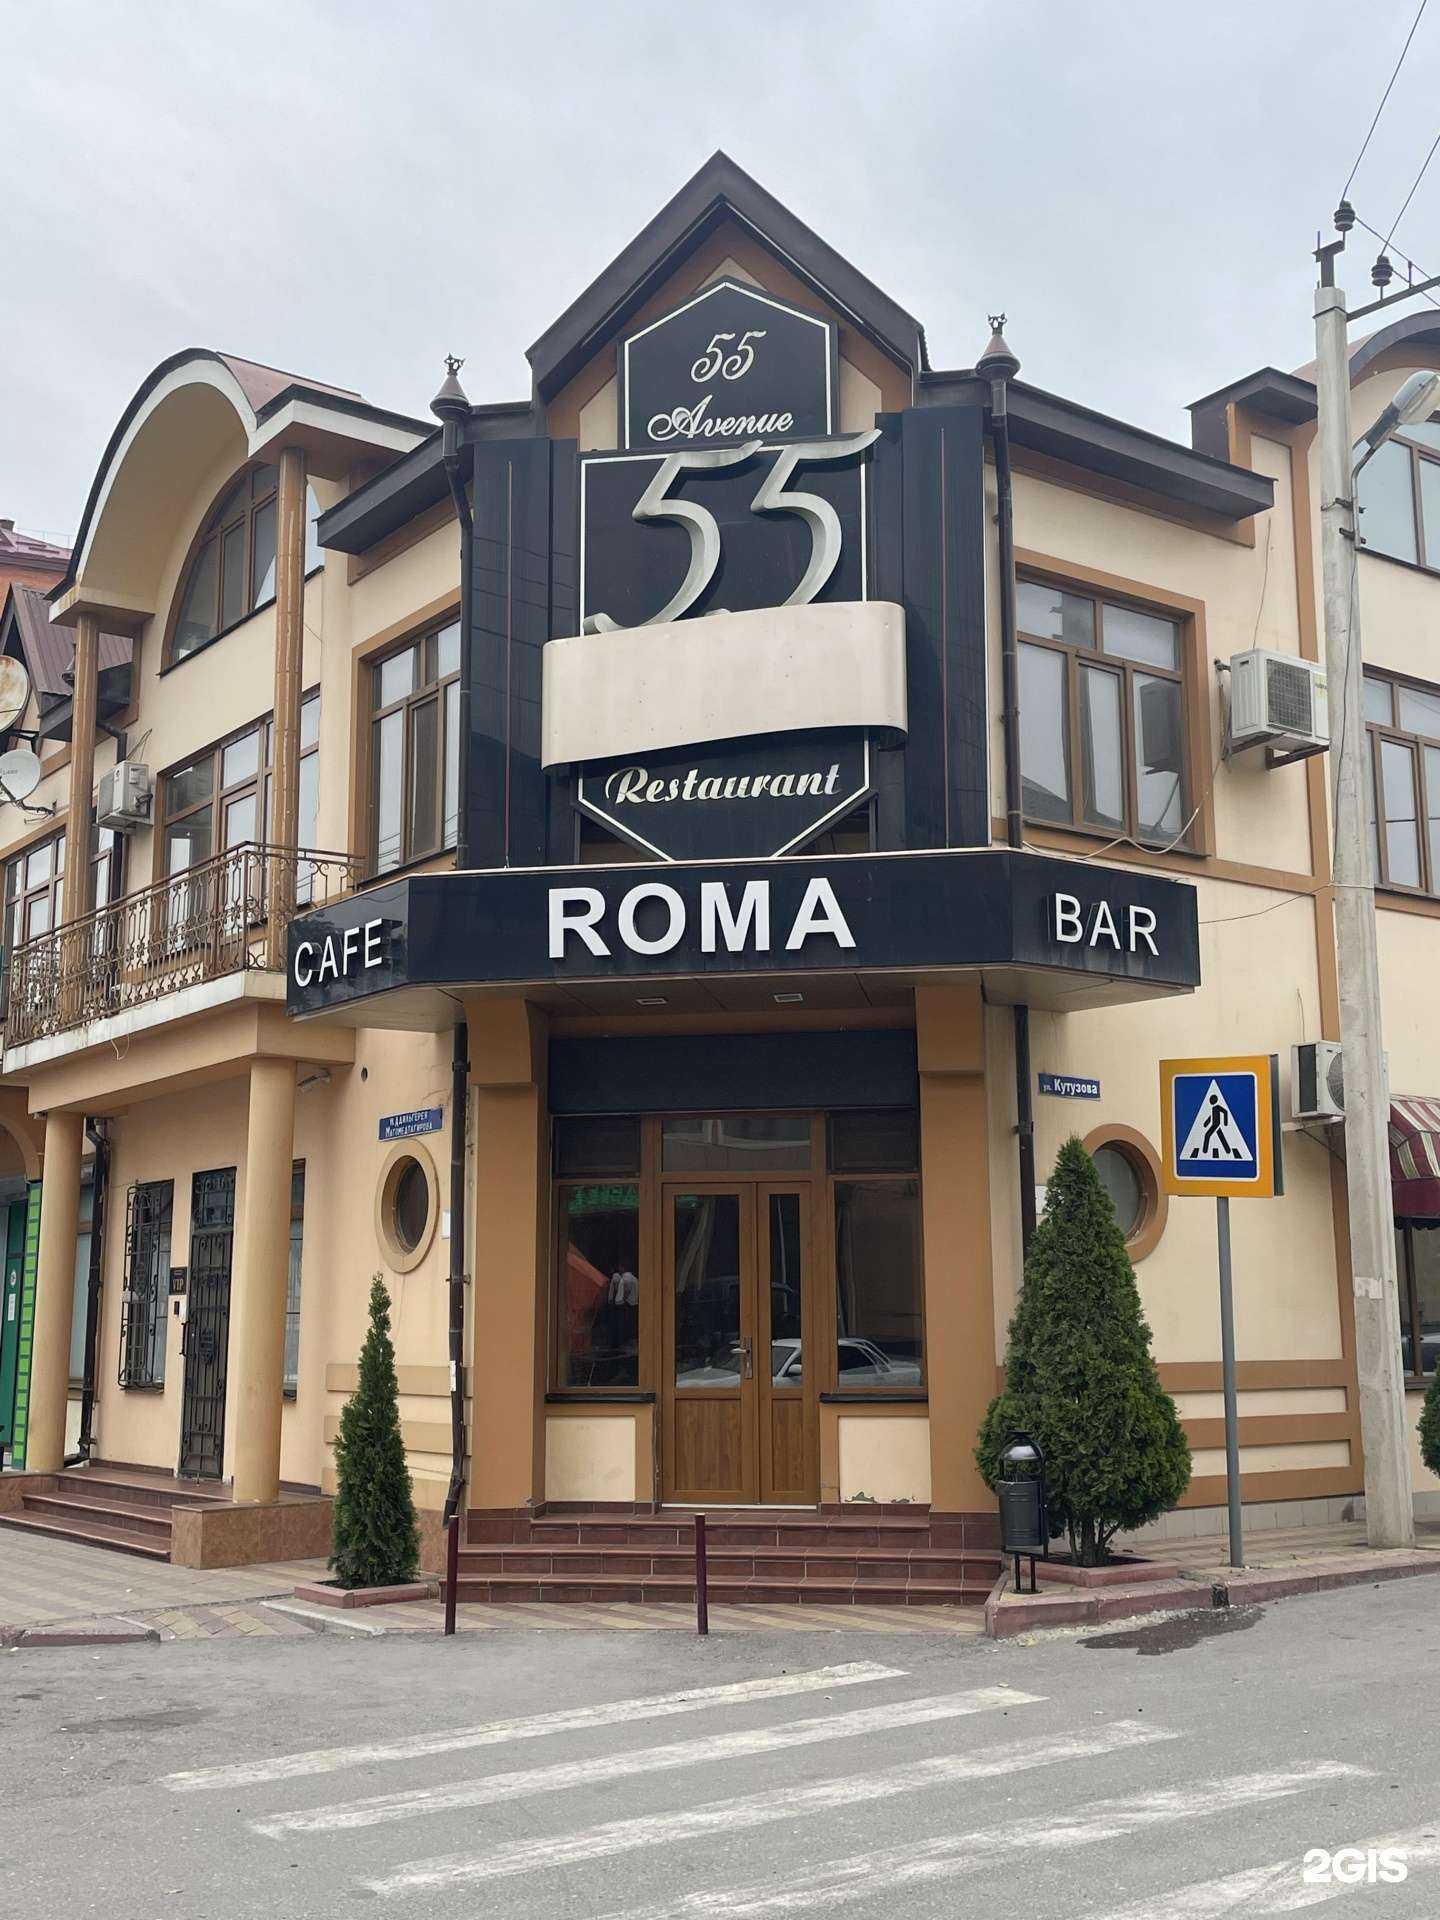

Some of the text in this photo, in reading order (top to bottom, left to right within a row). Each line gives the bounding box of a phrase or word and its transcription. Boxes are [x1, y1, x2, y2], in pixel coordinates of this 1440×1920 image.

[690, 330, 768, 384] 55
[647, 394, 794, 442] Avenue
[583, 428, 883, 634] 55
[604, 763, 842, 805] Restaurant
[548, 876, 858, 960] ROMA
[1055, 892, 1160, 956] BAR
[294, 917, 383, 987] CAFE
[1054, 1078, 1098, 1095] Кутузова
